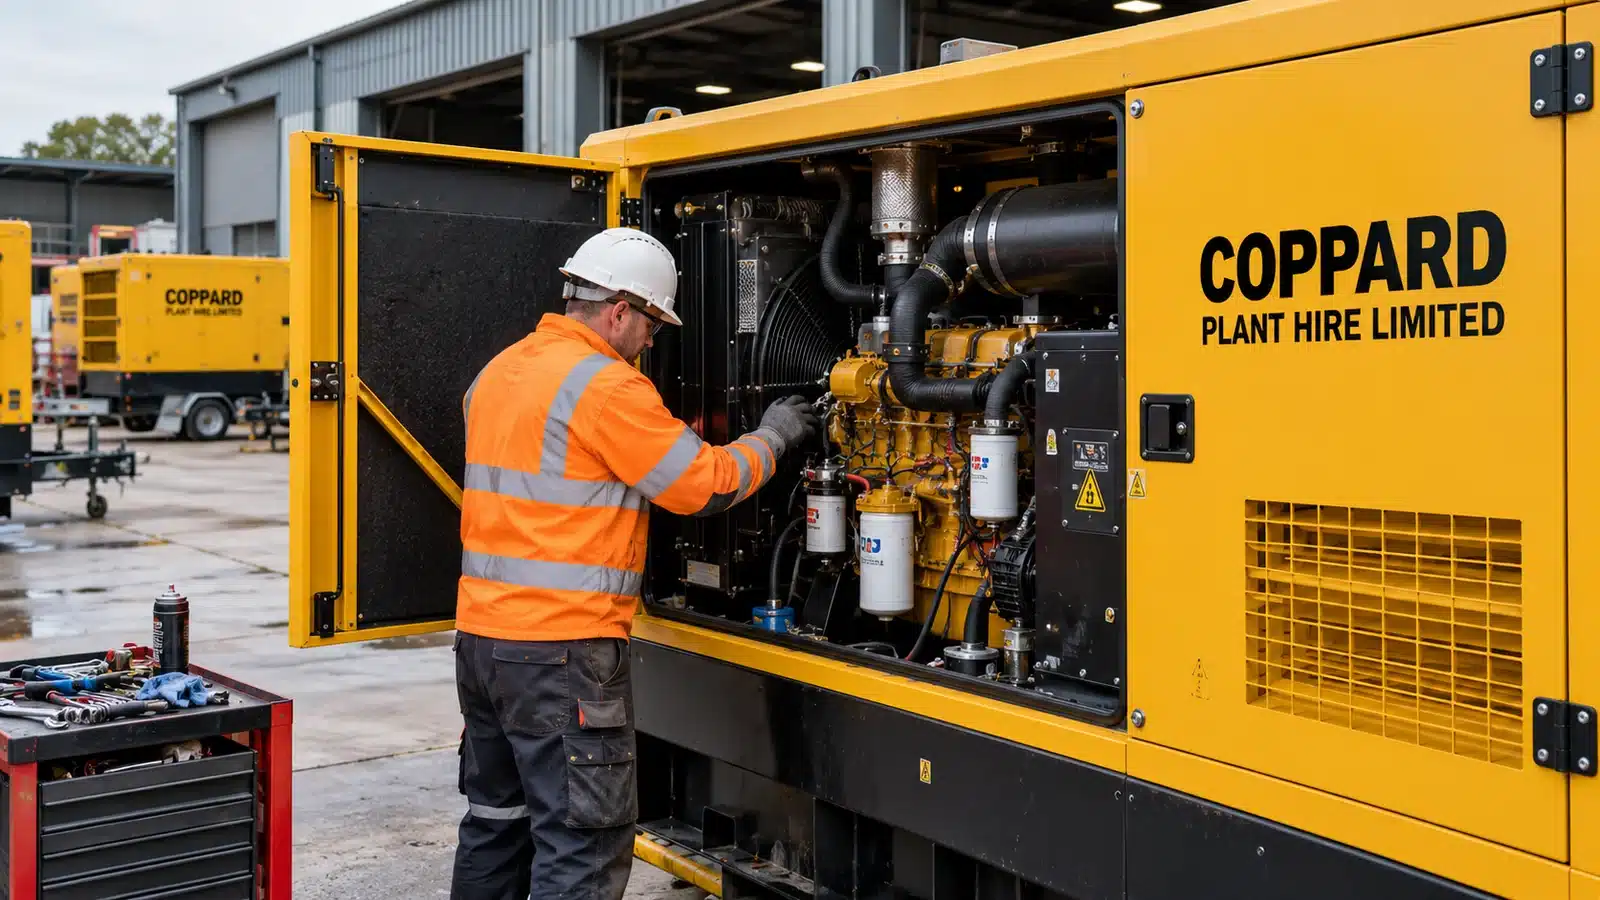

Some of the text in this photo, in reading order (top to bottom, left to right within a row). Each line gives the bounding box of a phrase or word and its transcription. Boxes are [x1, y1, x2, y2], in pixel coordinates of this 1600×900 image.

[1200, 209, 1507, 304] COPPARD
[165, 288, 243, 305] COPPARD
[165, 307, 191, 316] PLANT
[1202, 301, 1505, 346] PLANT HIRE LIMITED
